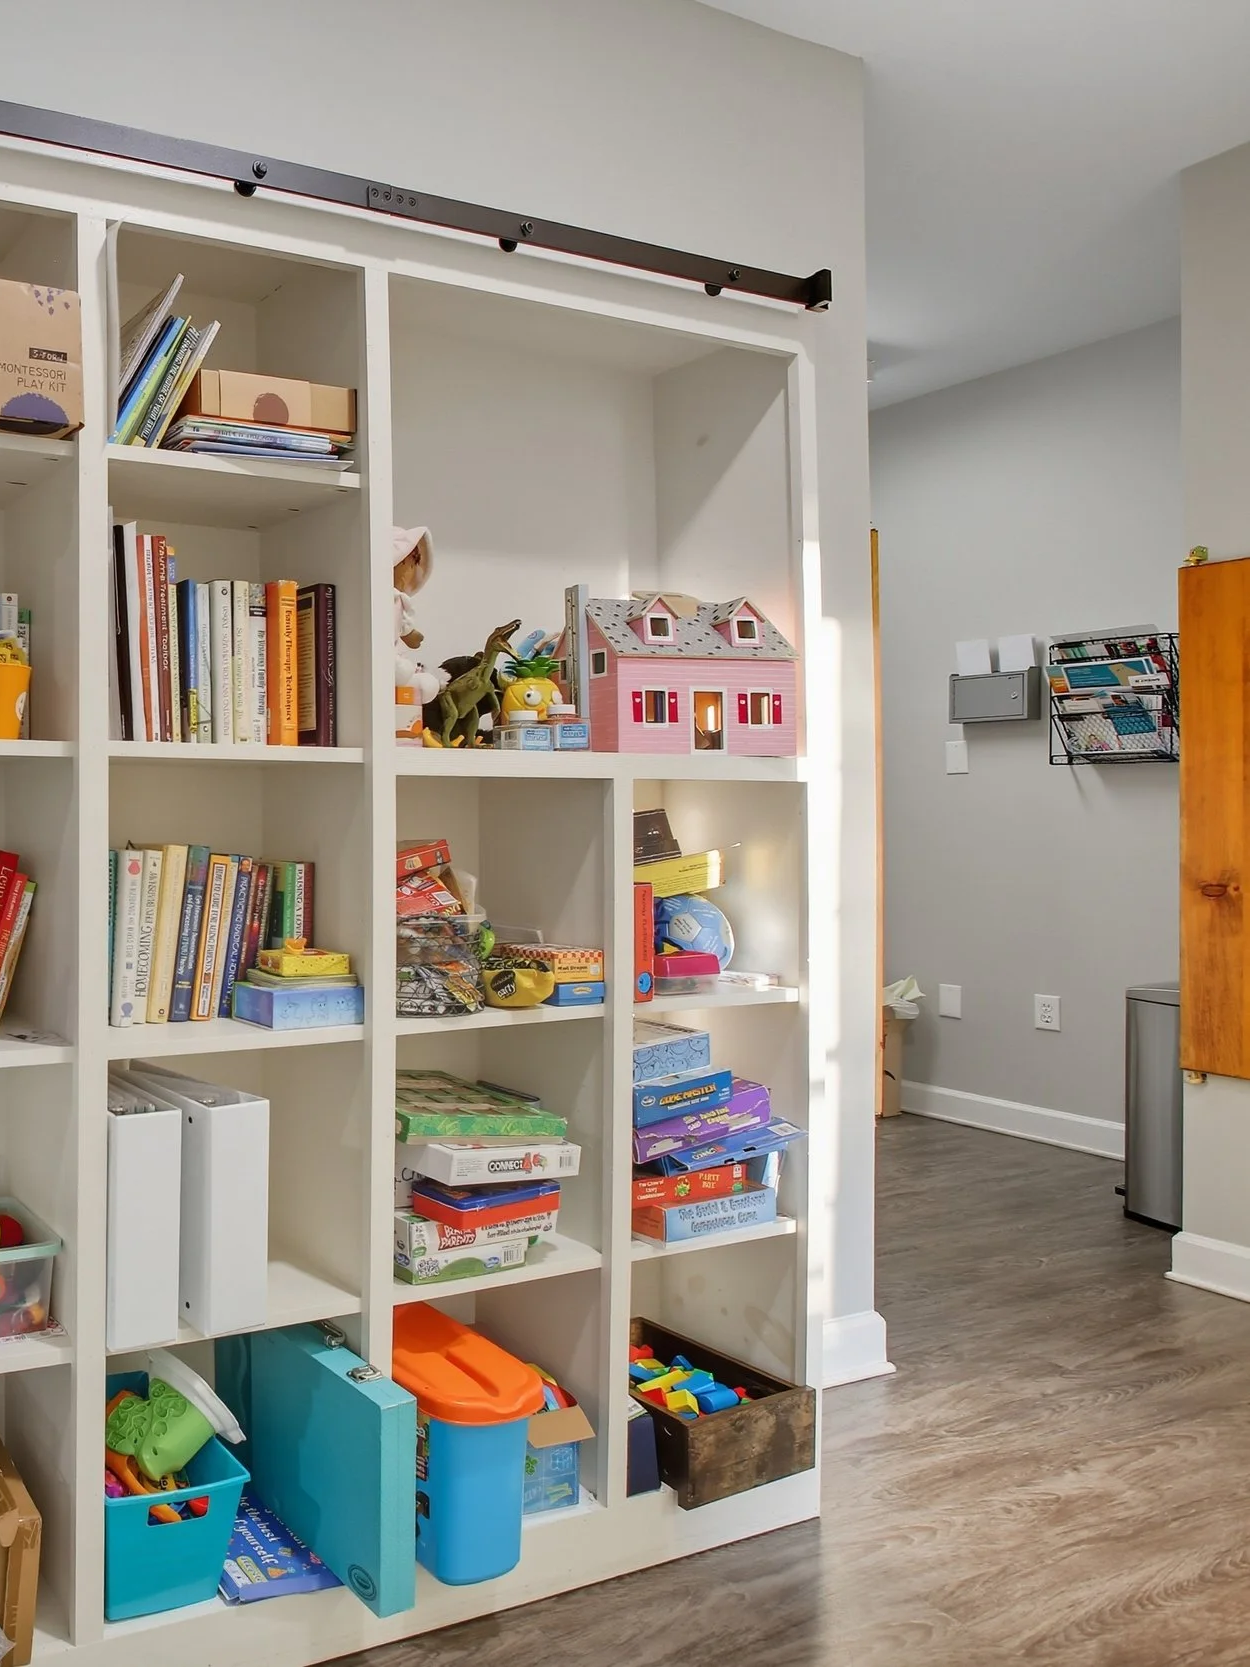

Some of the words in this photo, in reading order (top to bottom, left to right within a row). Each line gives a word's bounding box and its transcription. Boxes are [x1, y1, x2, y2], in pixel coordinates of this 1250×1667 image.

[17, 376, 45, 391] PLAY
[48, 381, 67, 393] KIT
[158, 540, 167, 581] Trauma
[159, 583, 168, 631] Treatment
[284, 610, 293, 638] Family
[161, 634, 169, 670] Toolbox
[284, 640, 293, 674] Therapy
[284, 675, 293, 721] Techniques
[186, 893, 194, 904] and
[213, 882, 221, 890] TO
[233, 876, 248, 922] PRACTICING
[295, 868, 303, 903] RAISING
[210, 909, 218, 921] FOR
[295, 904, 302, 912] A
[230, 923, 242, 958] RADICAL
[294, 913, 302, 939] LOVIN
[134, 925, 152, 998] HOMECOMING
[175, 955, 187, 976] Therapy
[204, 944, 214, 972] PARENTS
[225, 958, 237, 994] HONESTY
[691, 1215, 736, 1232] Competence
[737, 1211, 758, 1224] Game
[696, 1202, 718, 1219] Social
[729, 1193, 766, 1211] Emotional
[439, 1233, 476, 1249] PARENTS
[246, 1507, 261, 1522] the
[257, 1521, 282, 1543] best
[234, 1525, 279, 1564] yourself
